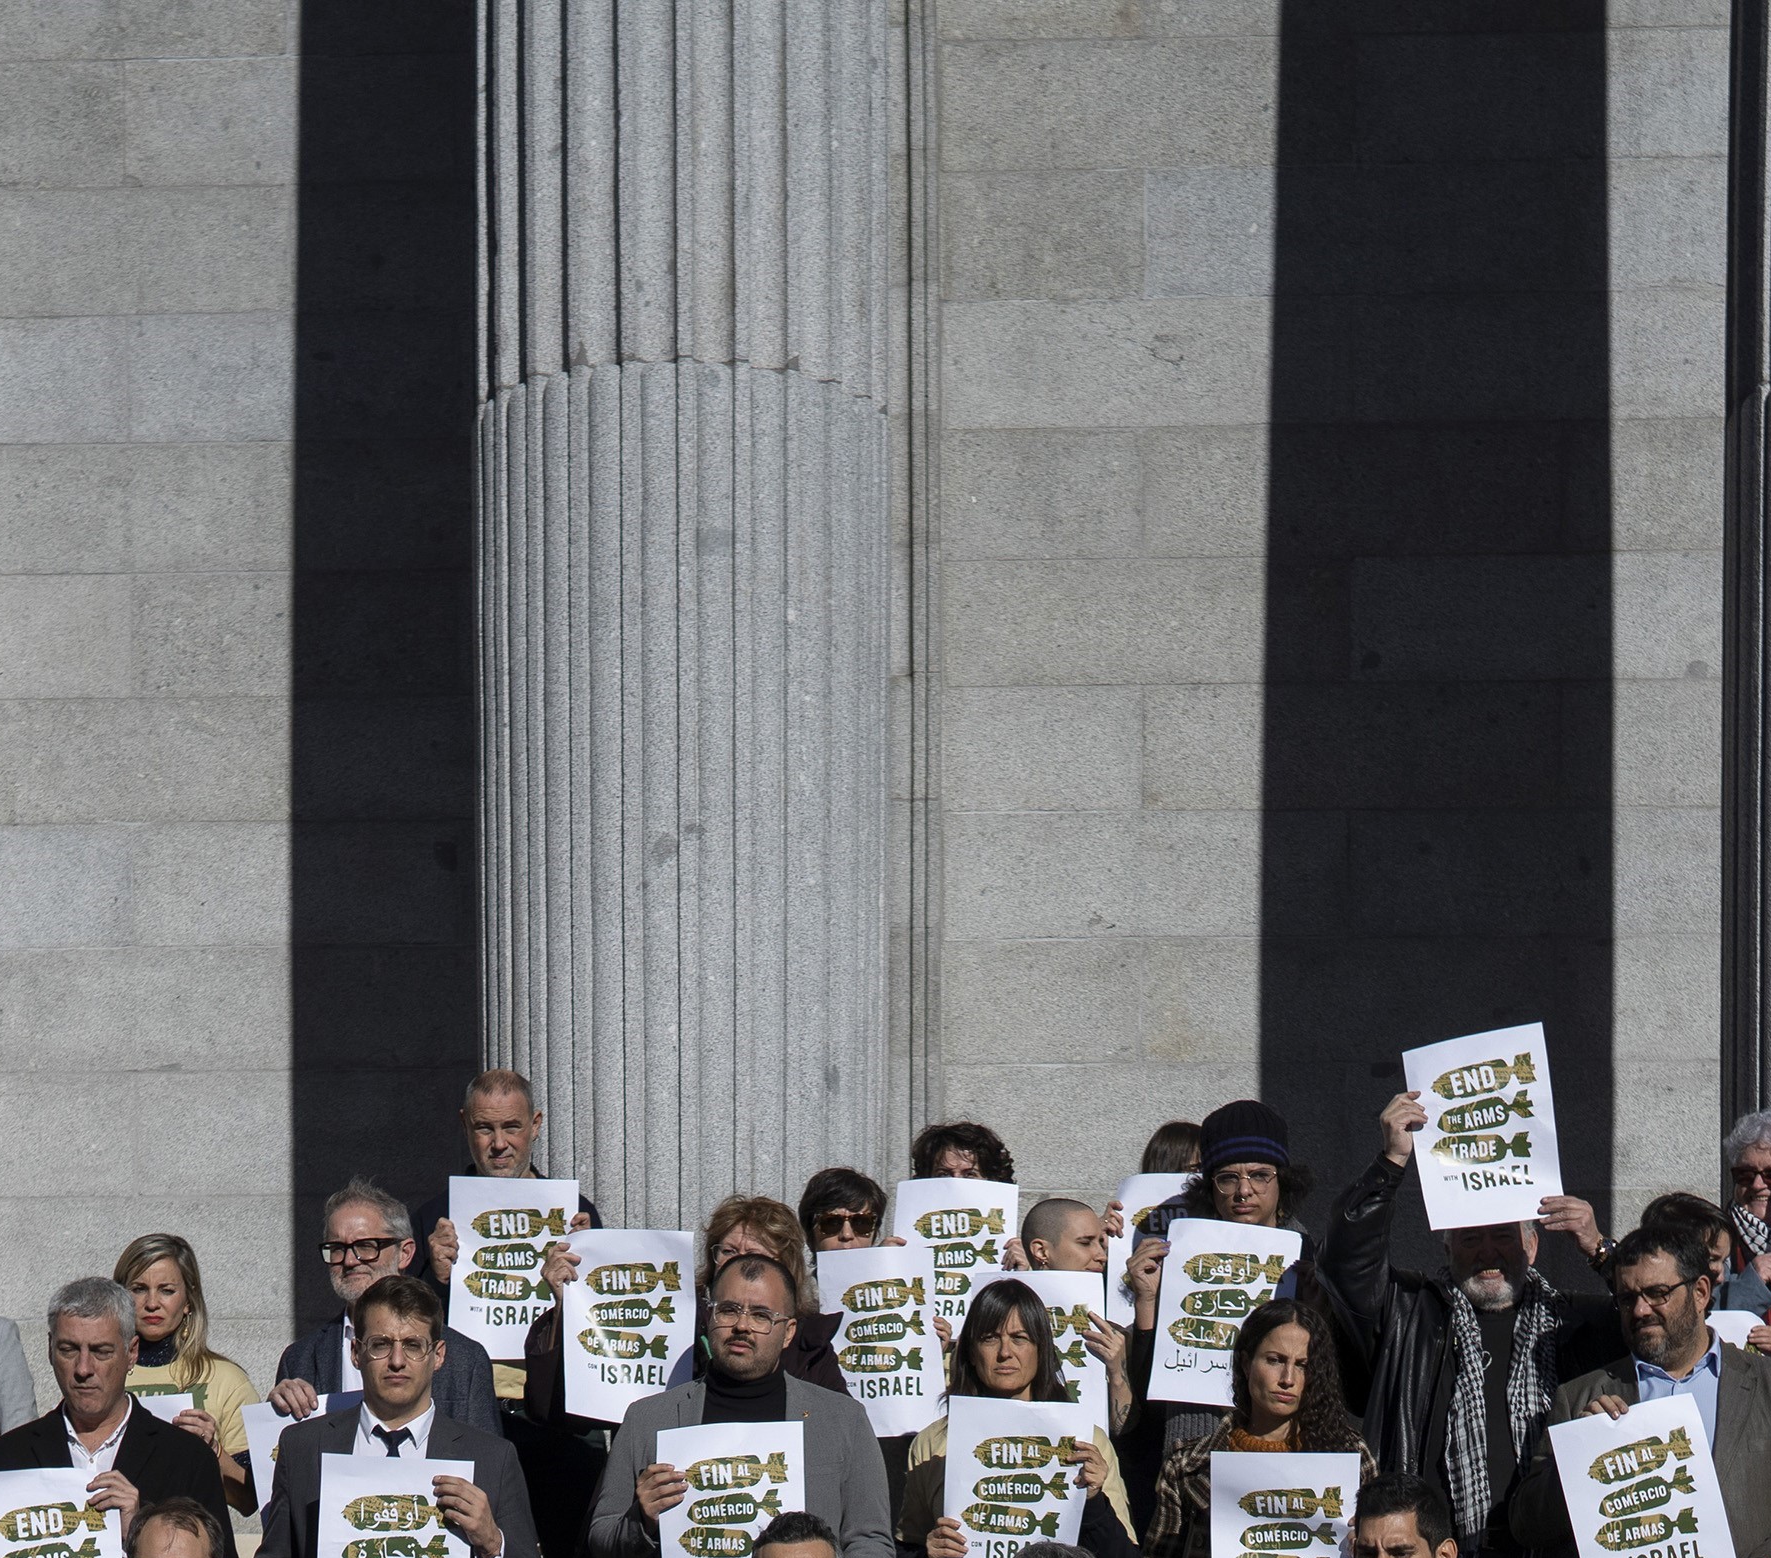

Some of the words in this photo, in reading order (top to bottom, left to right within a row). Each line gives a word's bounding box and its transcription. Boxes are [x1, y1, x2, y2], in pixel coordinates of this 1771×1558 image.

[1449, 1065, 1496, 1096] END
[1464, 1105, 1506, 1129] ARMS
[1450, 1140, 1497, 1159] TRADE
[1443, 1174, 1459, 1183] WITH
[488, 1212, 529, 1236] END
[930, 1213, 970, 1236] END
[496, 1252, 534, 1267] ARMS
[480, 1278, 524, 1296] TRADE
[601, 1270, 630, 1290] FIN
[854, 1287, 884, 1309] FIN
[1193, 1292, 1245, 1318] تجارة
[593, 1308, 650, 1322] COMERCIO
[850, 1322, 903, 1339] COMERCIO
[859, 1354, 896, 1367] ARMAS
[600, 1364, 666, 1386] ISRAEL
[860, 1376, 923, 1399] ISRAEL
[990, 1443, 1023, 1464] FIN
[1603, 1449, 1640, 1480] FIN
[700, 1463, 732, 1486] FIN
[980, 1482, 1041, 1495] COMERCIO
[1255, 1496, 1288, 1515] FIN
[1605, 1485, 1667, 1514] COMERCIO
[693, 1502, 754, 1521] COMERCIO
[989, 1513, 1030, 1529] ARMAS
[16, 1508, 65, 1537] END
[1625, 1522, 1666, 1541] ARMAS
[706, 1537, 746, 1551] ARMAS
[1247, 1530, 1309, 1545] COMERCIO
